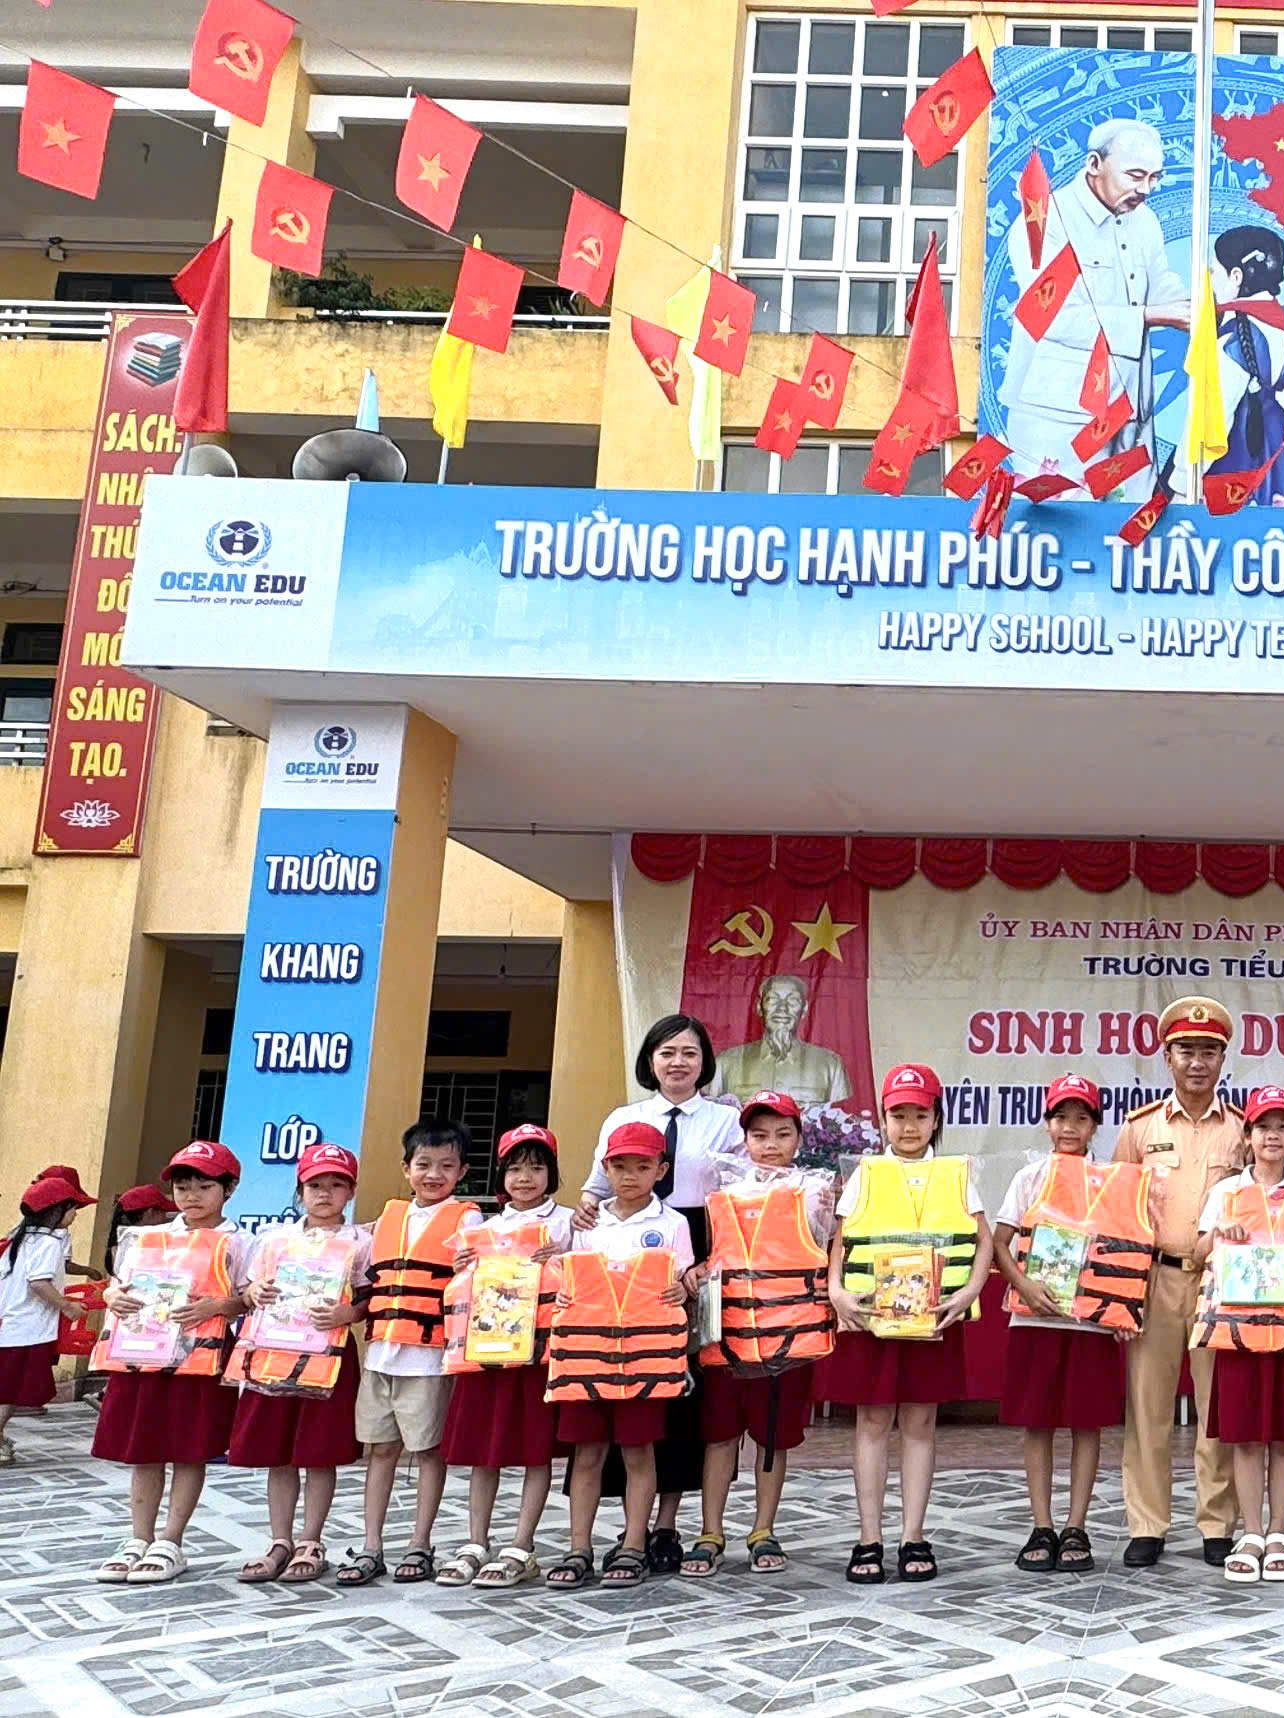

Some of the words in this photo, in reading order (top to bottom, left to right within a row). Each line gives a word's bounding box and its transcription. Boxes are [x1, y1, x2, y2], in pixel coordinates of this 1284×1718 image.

[496, 510, 681, 579] TRƯỜNG
[693, 525, 787, 596] HỌC
[799, 528, 926, 597] HẠNH
[939, 521, 1062, 590] PHÚC
[1104, 520, 1221, 595] THẦY
[160, 571, 247, 592] OCEAN
[254, 574, 306, 594] EDU
[190, 595, 210, 603] Turn
[230, 597, 253, 606] your
[255, 598, 304, 607] potential
[878, 611, 983, 652] HAPPY
[990, 614, 1112, 656] SCHOOL
[1140, 617, 1250, 658] HAPPY
[67, 680, 146, 722] SÁNG
[70, 742, 127, 784] TẠO.
[285, 762, 341, 775] OCEAN
[345, 763, 379, 776] EDU
[265, 849, 378, 893] TRƯỜNG
[980, 913, 1020, 938] ỦY
[1029, 921, 1091, 938] BAN
[1100, 918, 1184, 941] NHÂN
[1192, 918, 1254, 942] DÂN
[260, 943, 361, 980] KHANG
[1084, 956, 1210, 977] TRƯỜNG
[253, 1032, 349, 1070] TRANG
[969, 1010, 1085, 1055] SINH
